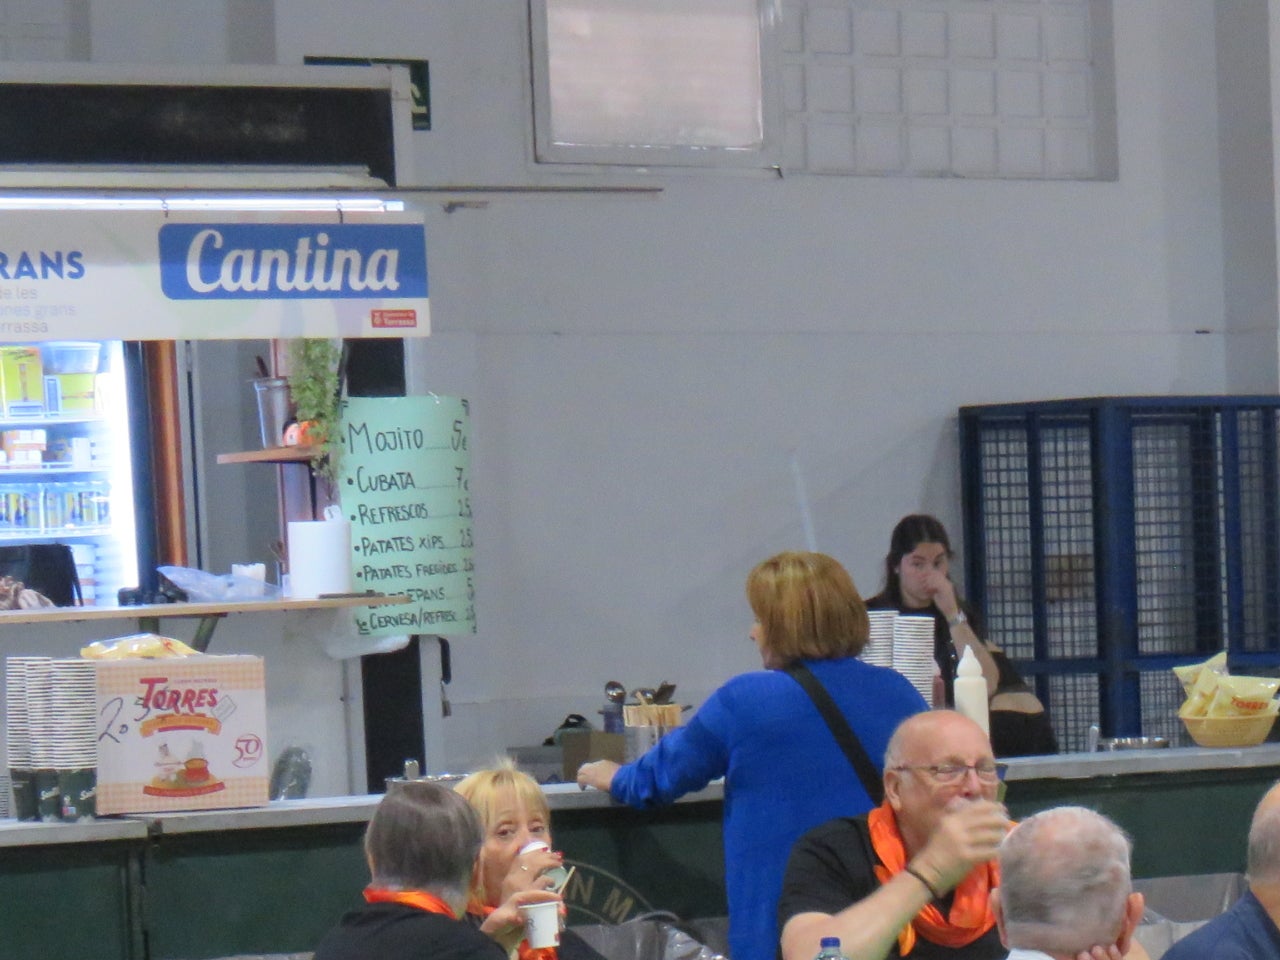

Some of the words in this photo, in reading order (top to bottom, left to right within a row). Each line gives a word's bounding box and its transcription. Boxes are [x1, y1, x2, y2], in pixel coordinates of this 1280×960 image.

[186, 229, 400, 293] Cantina
[357, 465, 416, 493] CUBATA
[358, 502, 428, 525] REFRESCOS
[360, 536, 415, 557] PATATES
[362, 564, 413, 581] PATATES
[139, 677, 219, 715] TORRES
